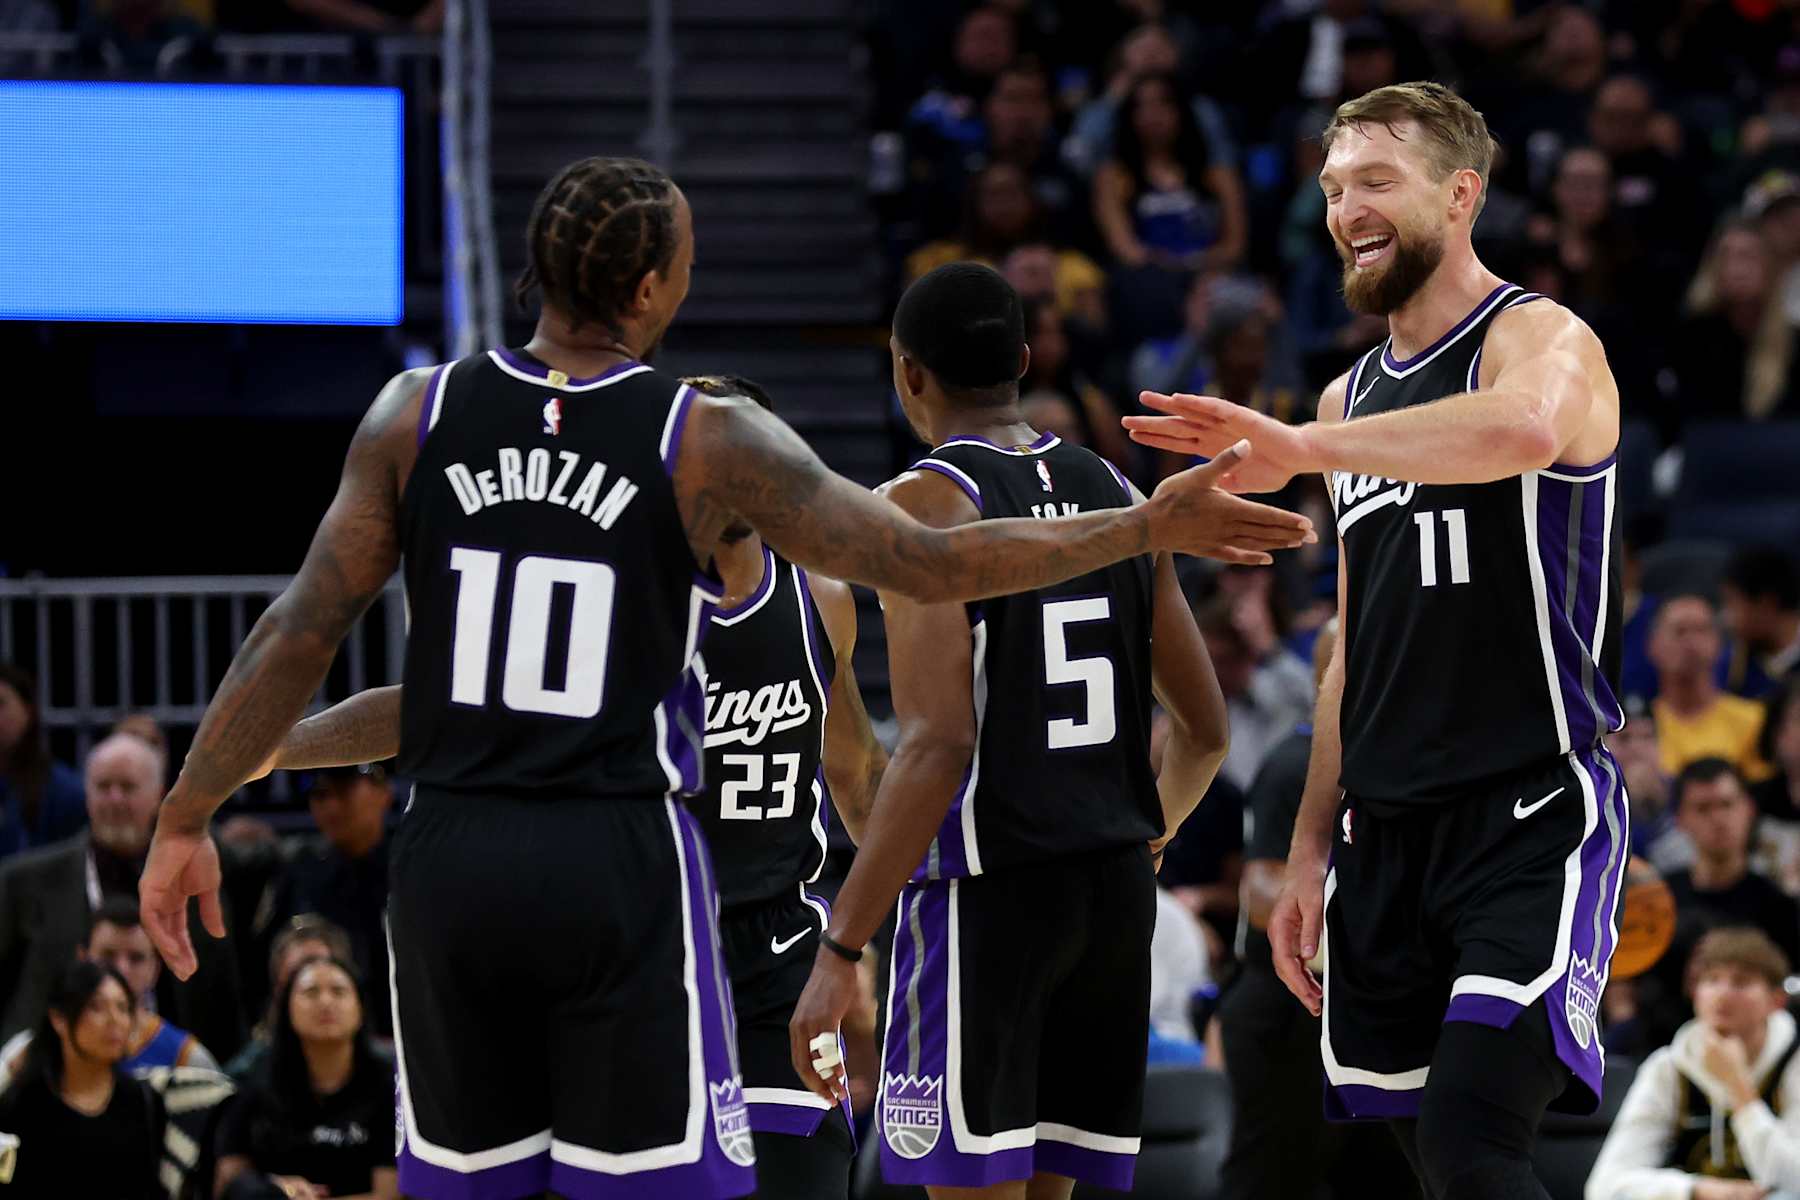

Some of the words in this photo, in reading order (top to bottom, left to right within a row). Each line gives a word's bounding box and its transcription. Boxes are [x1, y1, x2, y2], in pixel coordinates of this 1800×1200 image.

[1413, 508, 1470, 587] 11
[450, 547, 616, 718] 10
[1042, 597, 1117, 749] 5
[703, 679, 811, 748] ings
[720, 752, 801, 820] 23
[886, 1108, 939, 1126] KINGS
